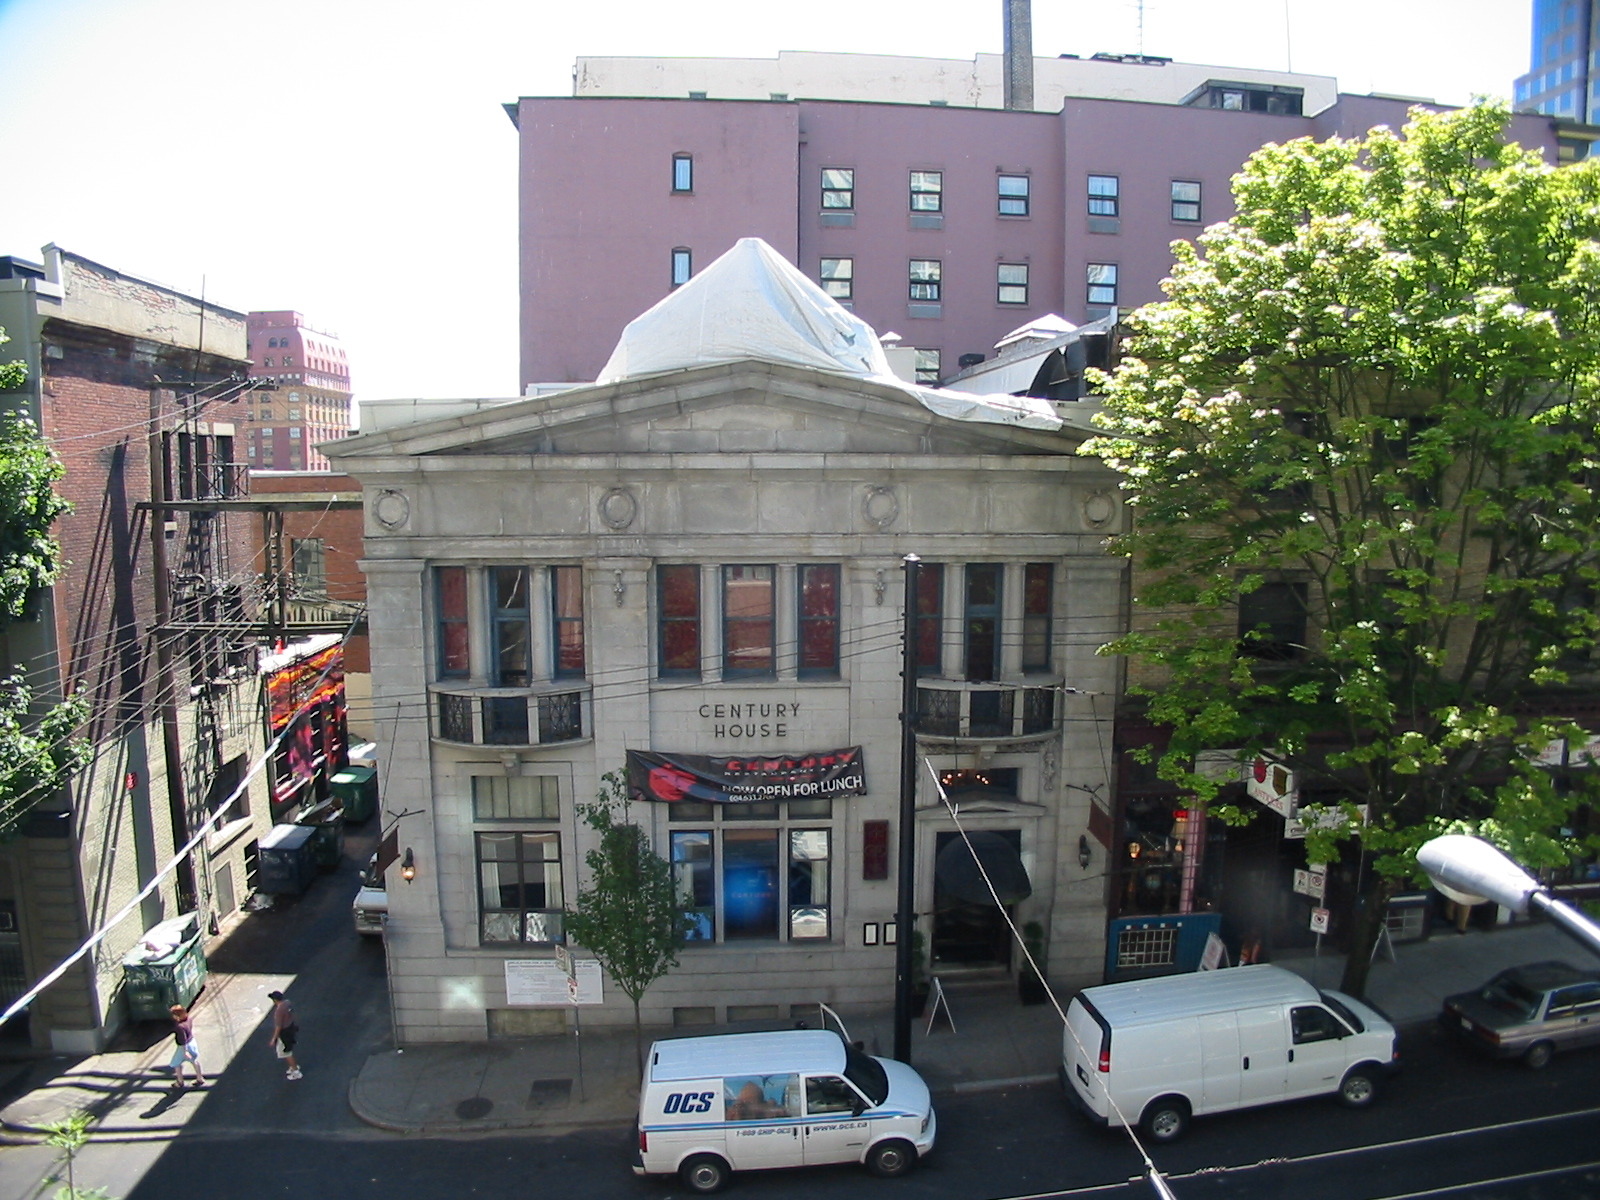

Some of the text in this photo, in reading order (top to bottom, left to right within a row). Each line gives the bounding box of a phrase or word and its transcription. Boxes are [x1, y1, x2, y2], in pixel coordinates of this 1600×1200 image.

[699, 703, 801, 718] CENTURY
[714, 723, 788, 738] HOUSE
[722, 775, 862, 797] NOW OPEN FOR LUNCH
[663, 1091, 714, 1114] OCS
